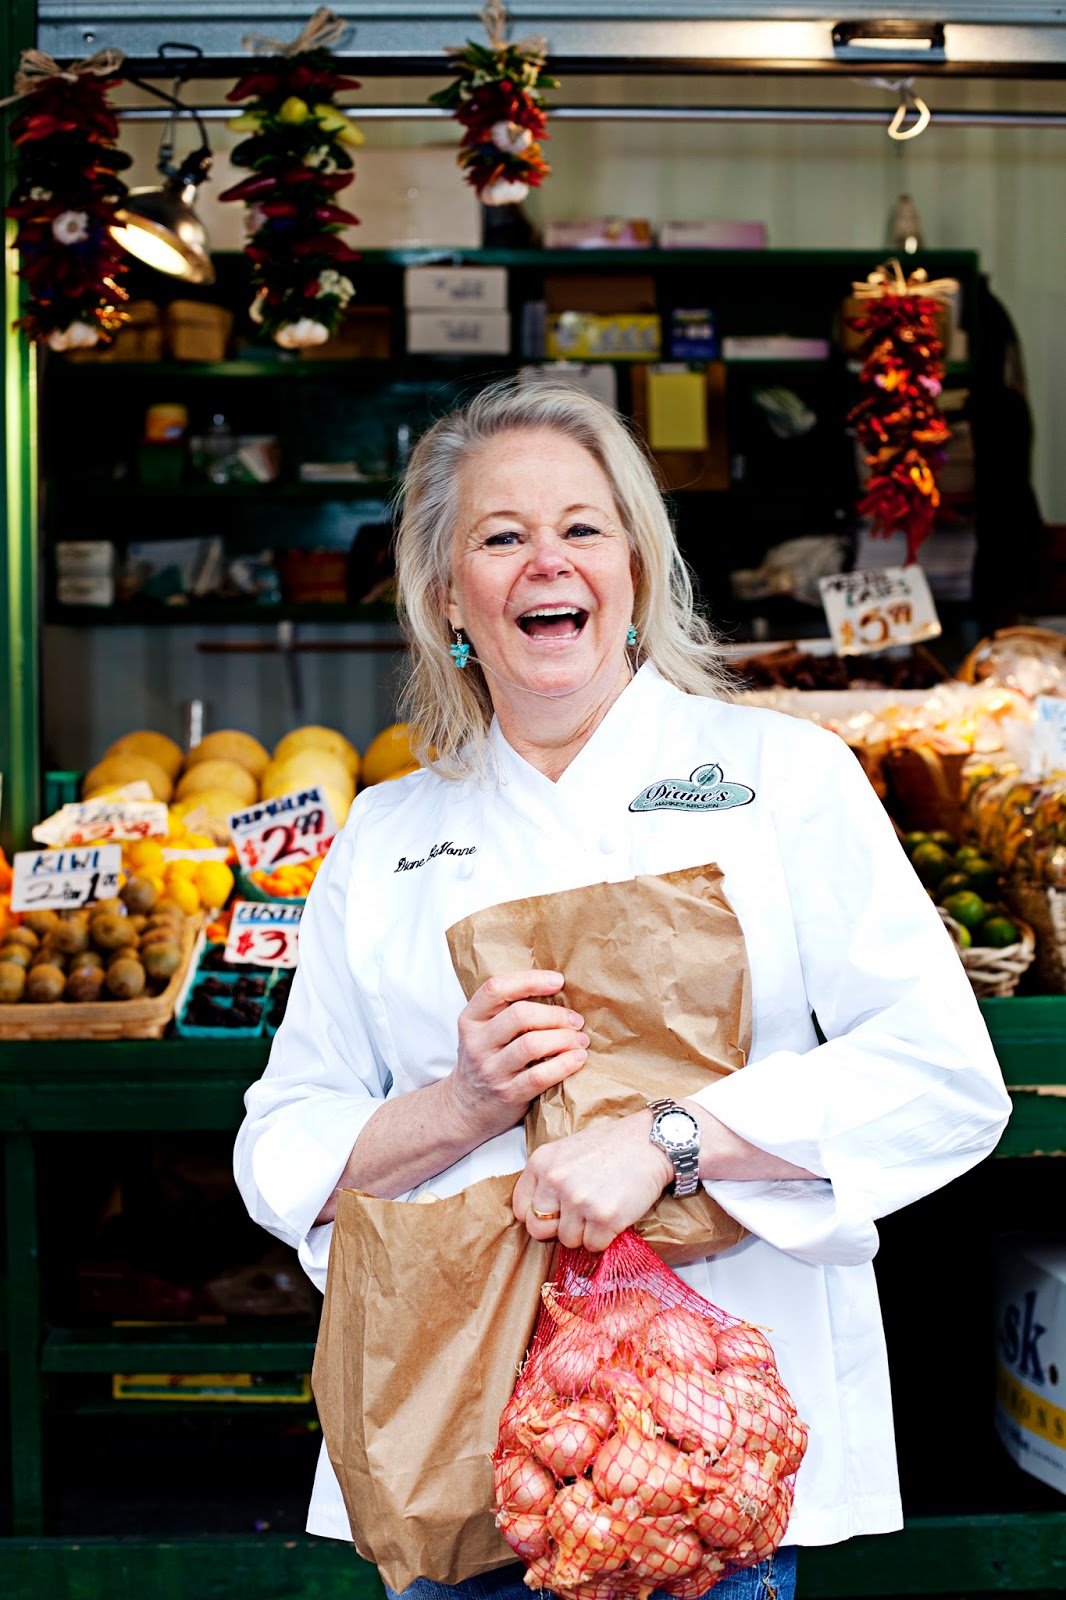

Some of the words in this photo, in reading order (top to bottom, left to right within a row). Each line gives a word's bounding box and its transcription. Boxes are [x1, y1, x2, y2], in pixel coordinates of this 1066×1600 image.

[645, 783, 731, 804] Diane's
[32, 851, 100, 874] KIWI
[394, 856, 425, 873] Diane
